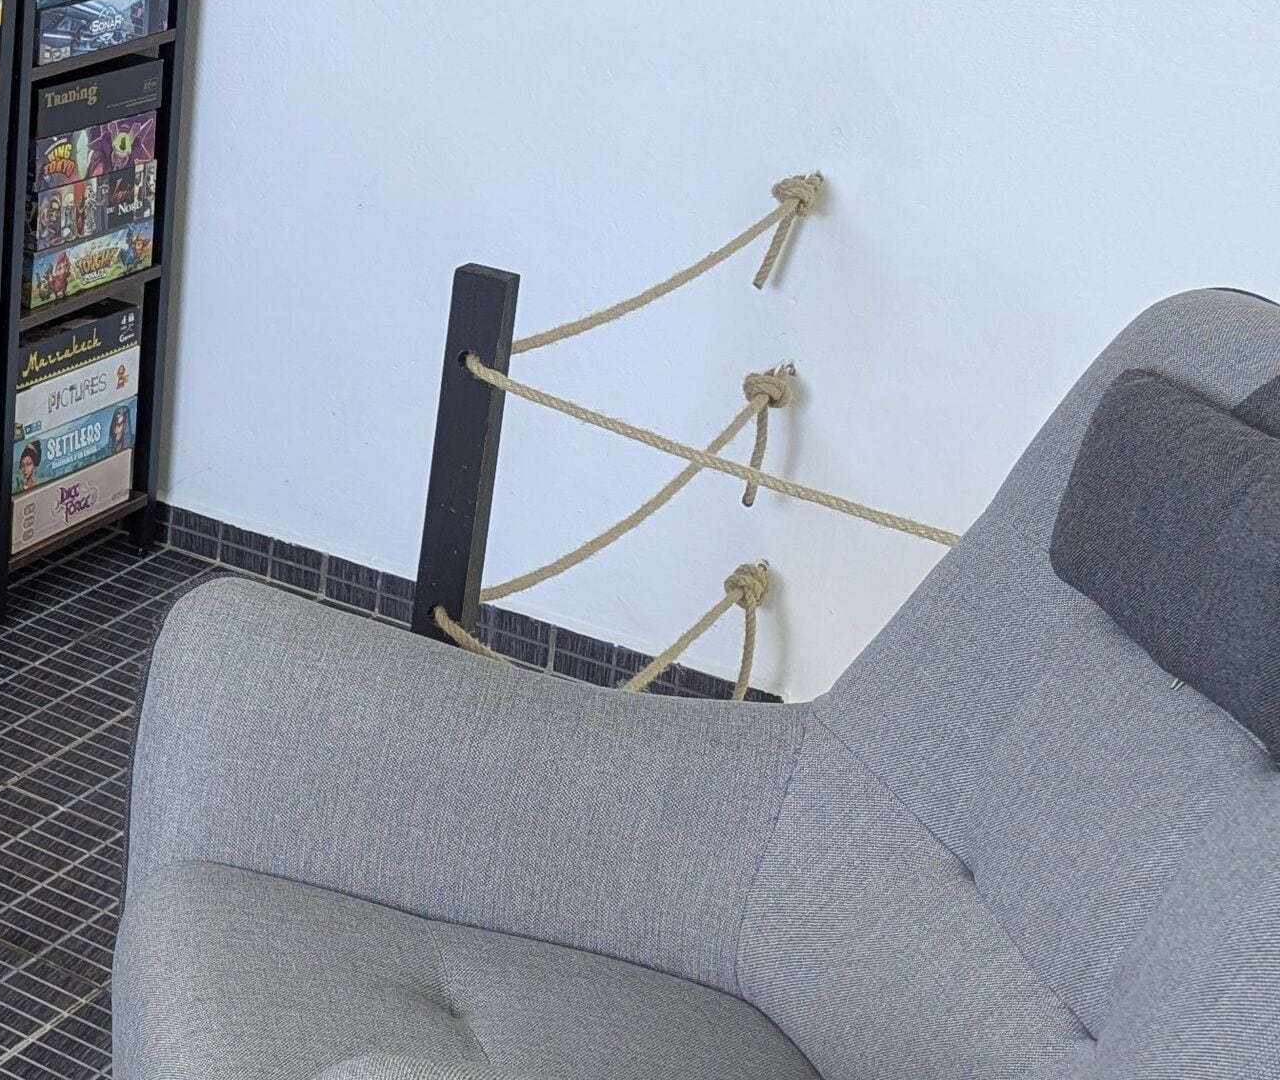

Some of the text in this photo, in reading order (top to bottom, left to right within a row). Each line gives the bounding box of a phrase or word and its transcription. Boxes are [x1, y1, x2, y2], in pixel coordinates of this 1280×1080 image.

[91, 14, 123, 34] SONAR
[44, 84, 99, 109] Trading
[48, 142, 72, 163] KING
[43, 159, 77, 179] TOKYO
[21, 327, 103, 379] Marrakech
[47, 372, 109, 415] PICTURES
[46, 421, 103, 461] SETTLERS
[58, 482, 81, 503] DICE
